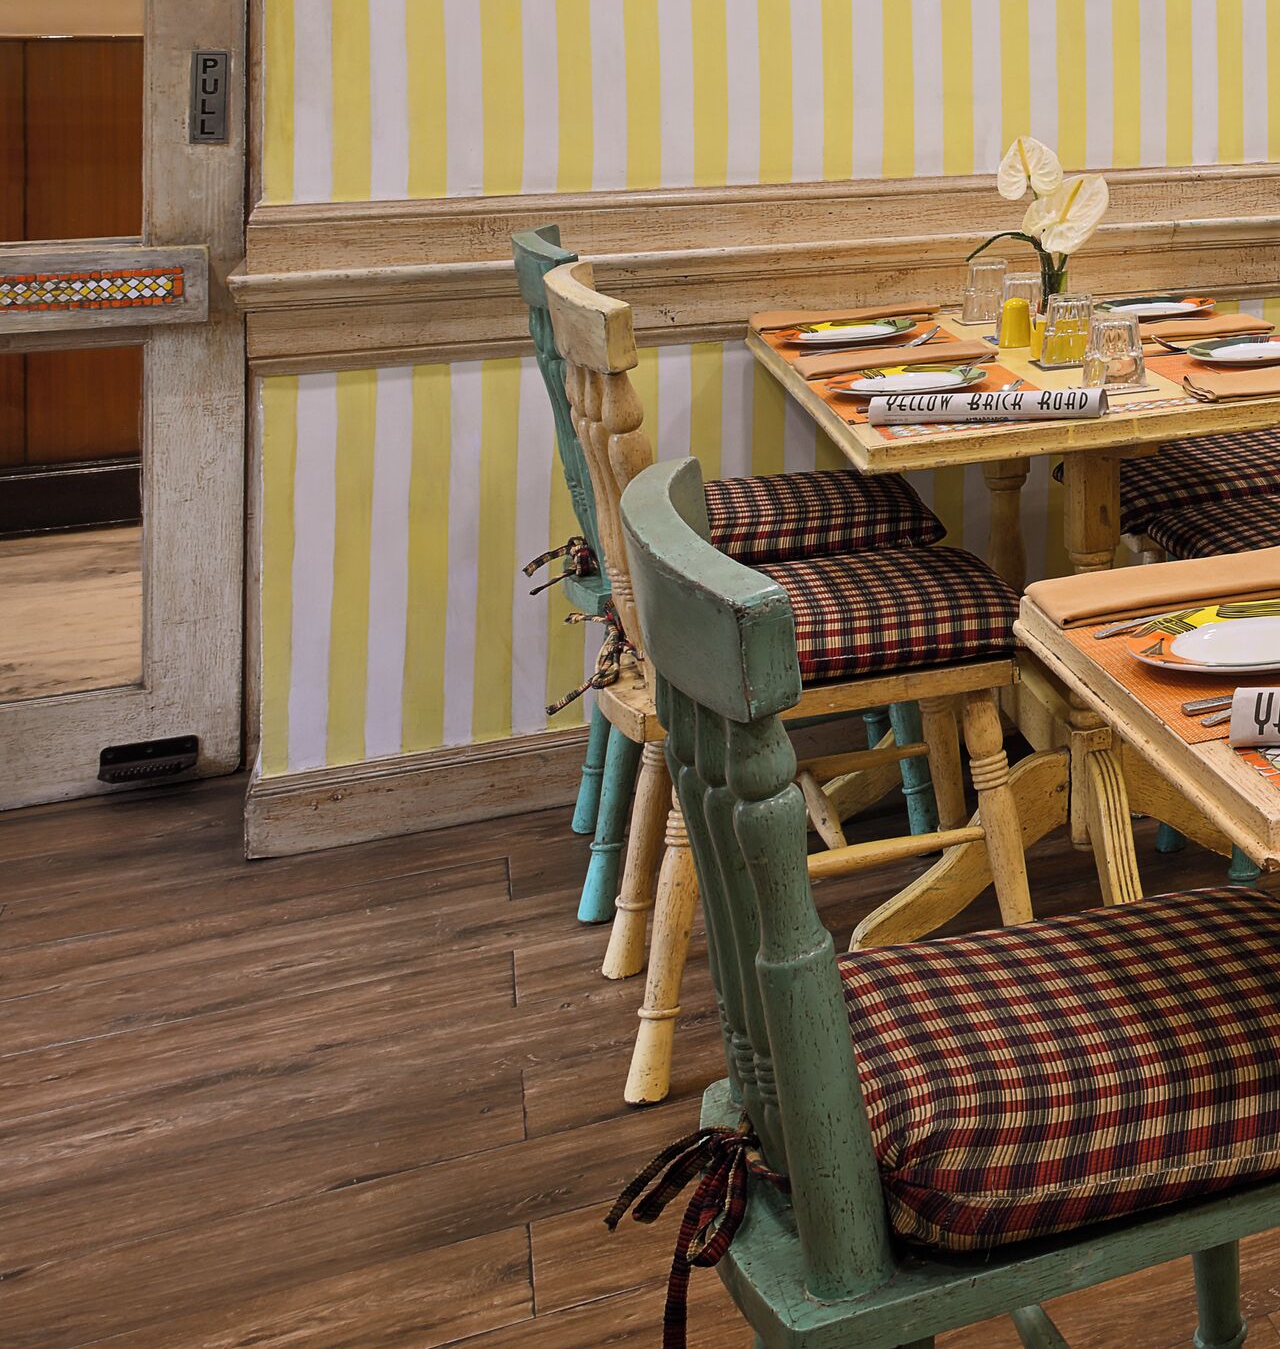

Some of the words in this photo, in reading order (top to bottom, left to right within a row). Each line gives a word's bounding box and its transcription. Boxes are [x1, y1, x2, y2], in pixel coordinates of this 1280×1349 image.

[200, 57, 219, 136] PULL
[885, 394, 954, 412] YELLOW
[966, 391, 1024, 411] BRICK
[1037, 390, 1089, 411] ROAD
